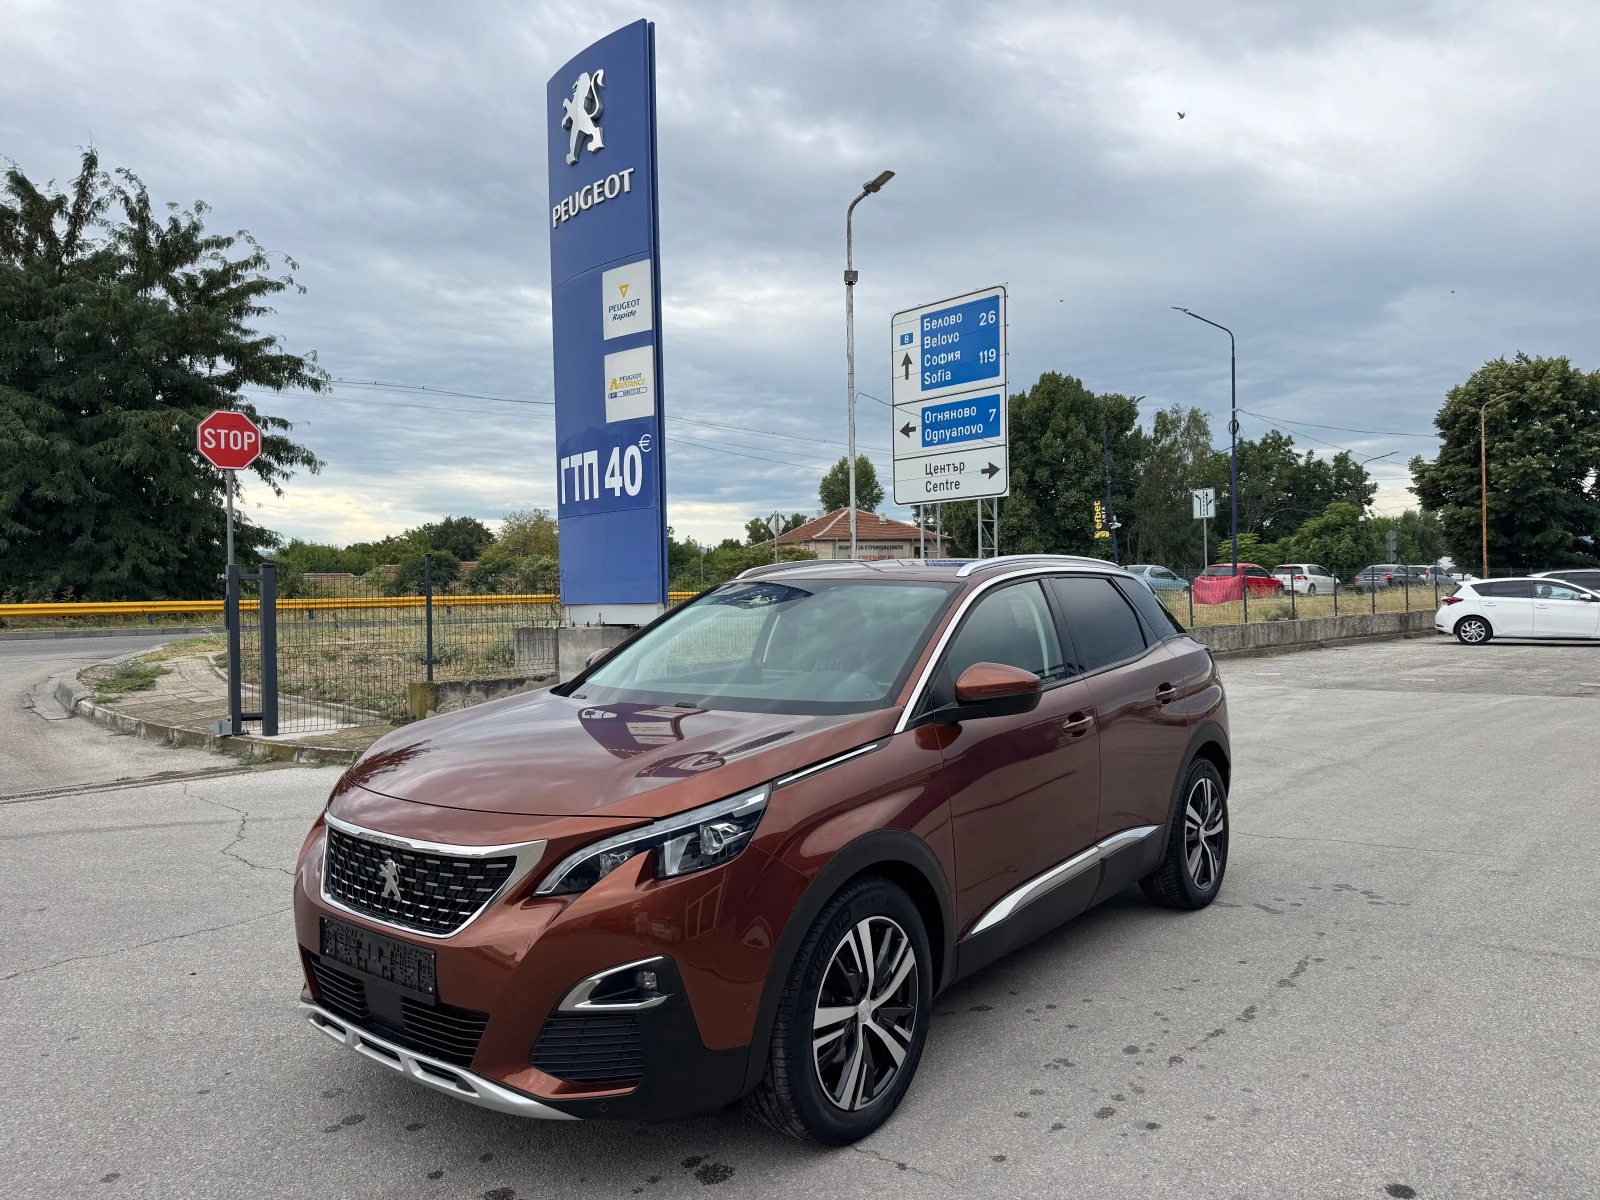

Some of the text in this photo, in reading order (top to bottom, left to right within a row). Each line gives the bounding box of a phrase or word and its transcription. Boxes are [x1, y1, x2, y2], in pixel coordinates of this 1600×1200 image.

[552, 167, 635, 228] PEUGEOT
[608, 298, 641, 313] PEUGEOT
[612, 309, 637, 321] Rapide
[924, 310, 996, 331] Белово 26
[904, 335, 910, 344] 8
[924, 331, 960, 349] Belovo
[924, 348, 997, 367] София 119
[619, 372, 642, 382] PEUGEOT
[924, 368, 952, 385] Sofia
[924, 405, 997, 424] Огняново 7
[203, 428, 256, 451] STOP
[924, 422, 984, 443] Ognyanovo
[560, 449, 600, 504] ГТП
[925, 460, 966, 476] Център
[925, 478, 961, 493] Centre
[1093, 500, 1103, 530] efbet
[810, 909, 852, 984] MICHELIN
